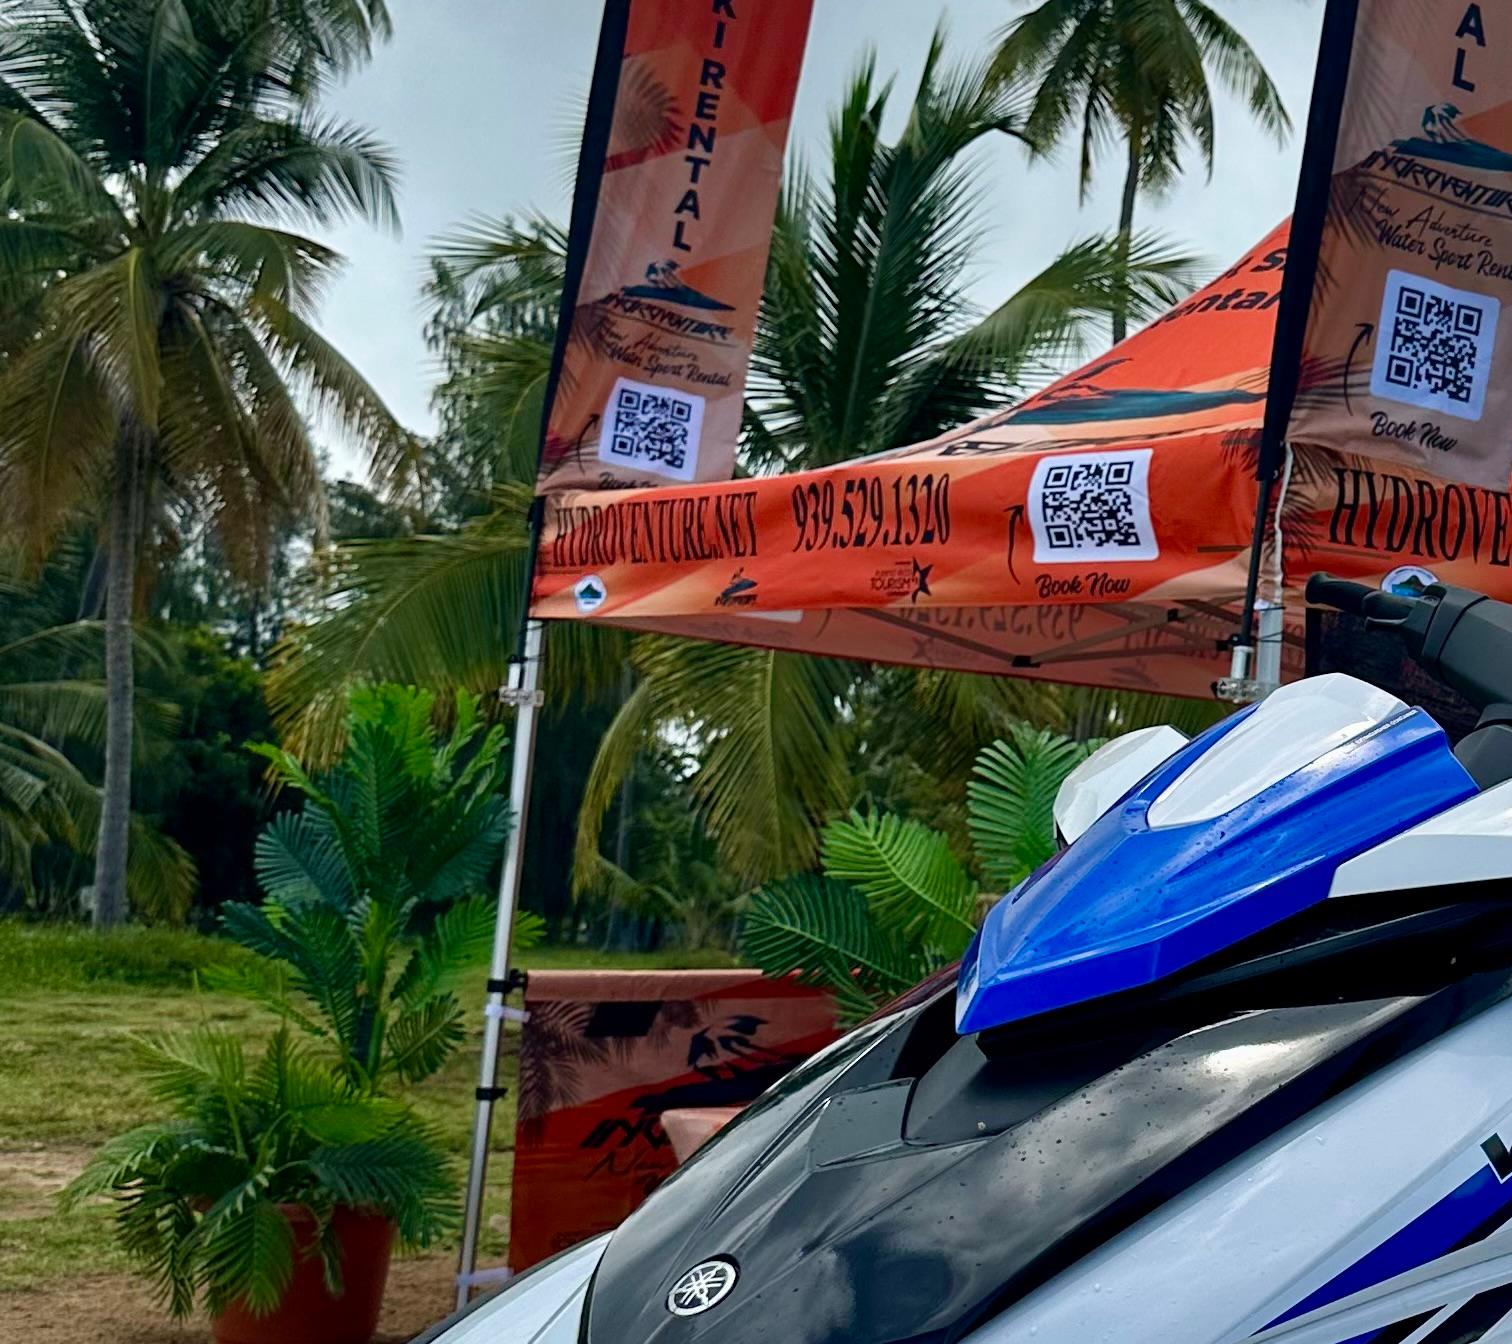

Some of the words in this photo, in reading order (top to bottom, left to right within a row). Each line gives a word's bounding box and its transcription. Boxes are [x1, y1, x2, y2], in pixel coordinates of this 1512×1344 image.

[673, 58, 727, 253] RENTAL
[1376, 220, 1425, 254] Water
[1428, 238, 1474, 271] Sport
[1405, 205, 1493, 248] Adventure
[1370, 411, 1415, 441] Book
[1419, 422, 1458, 453] Now
[553, 491, 758, 567] HYDROVENTURE.NET
[792, 471, 951, 552] 939.529.1320
[1034, 574, 1082, 599] Book
[1086, 572, 1132, 595] Now
